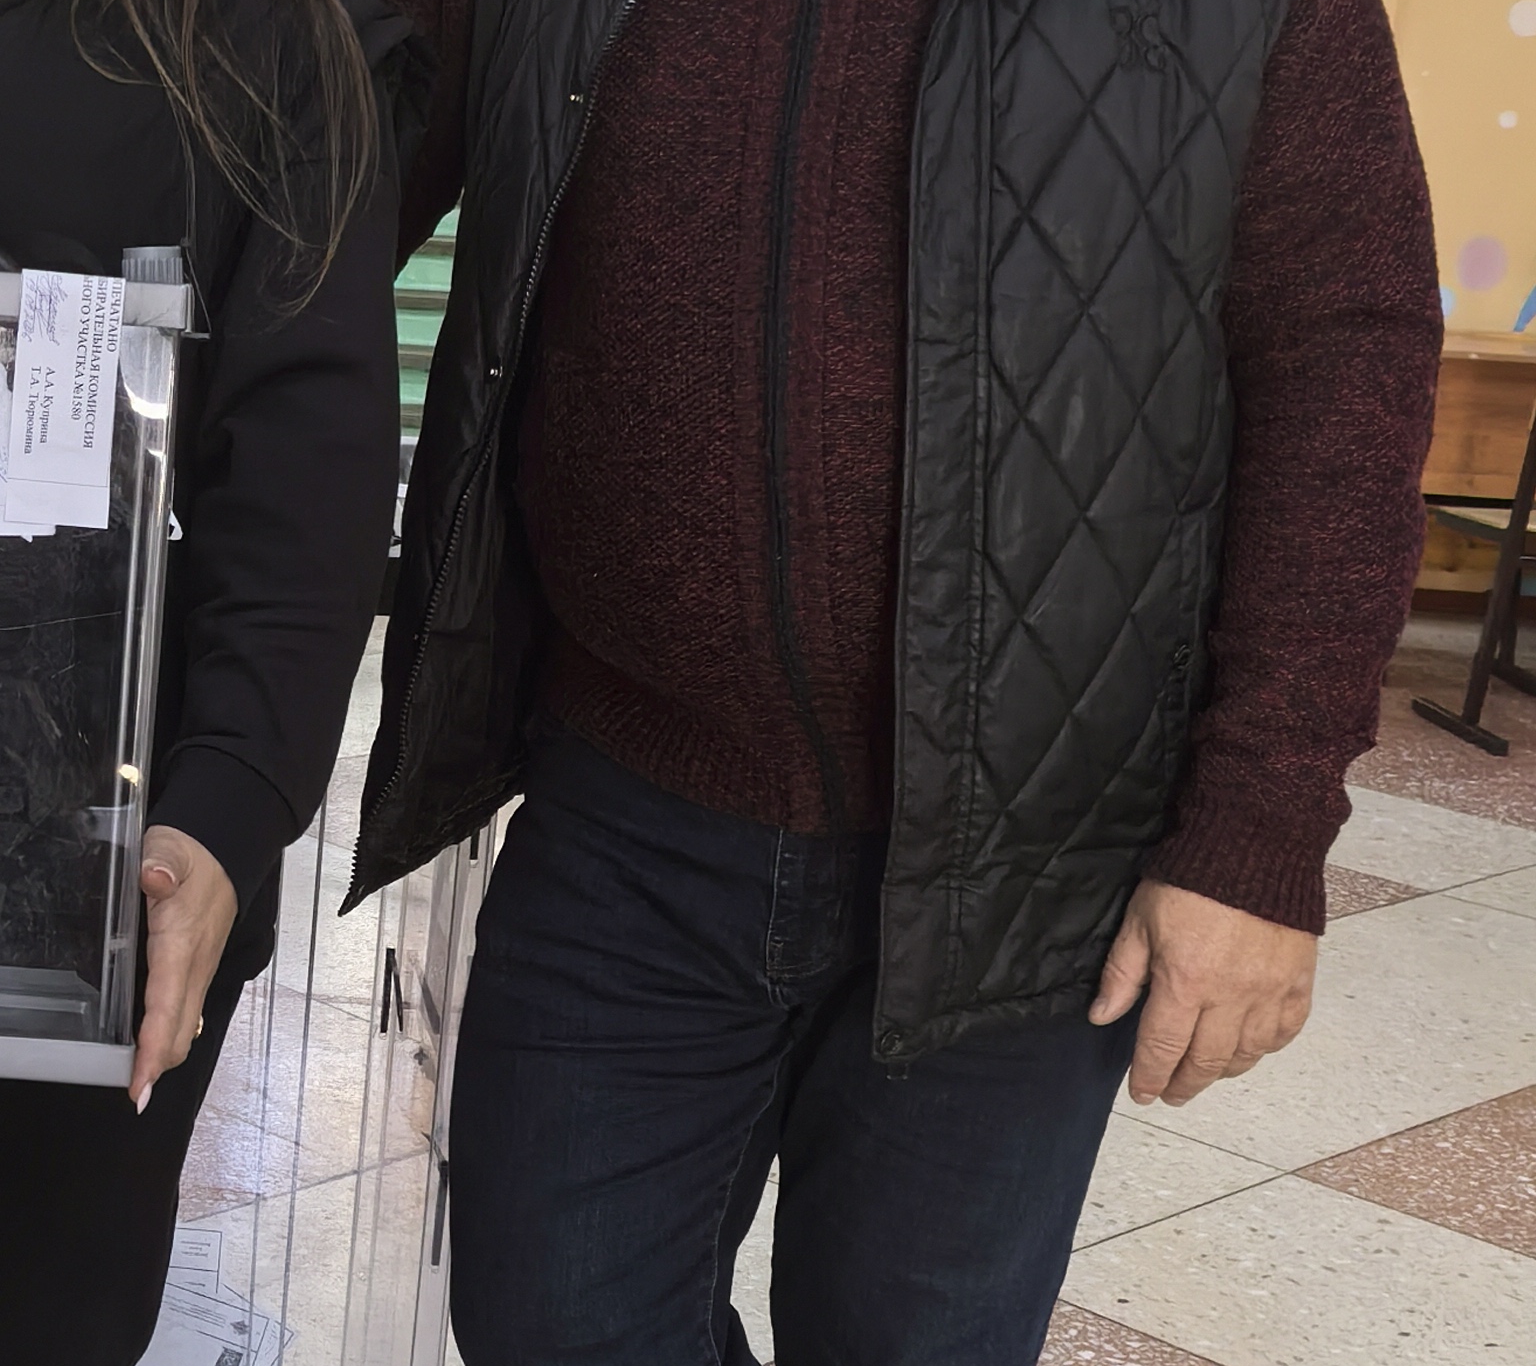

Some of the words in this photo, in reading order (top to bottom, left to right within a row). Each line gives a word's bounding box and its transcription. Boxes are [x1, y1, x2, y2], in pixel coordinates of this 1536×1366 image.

[107, 278, 123, 353] ПЕЧАТАНО
[75, 318, 91, 379] УЧАСТКА
[24, 392, 39, 454] Тюрюмина
[39, 395, 54, 444] Куприна
[71, 382, 84, 421] №1580
[83, 375, 100, 449] КОМИССИЯ
